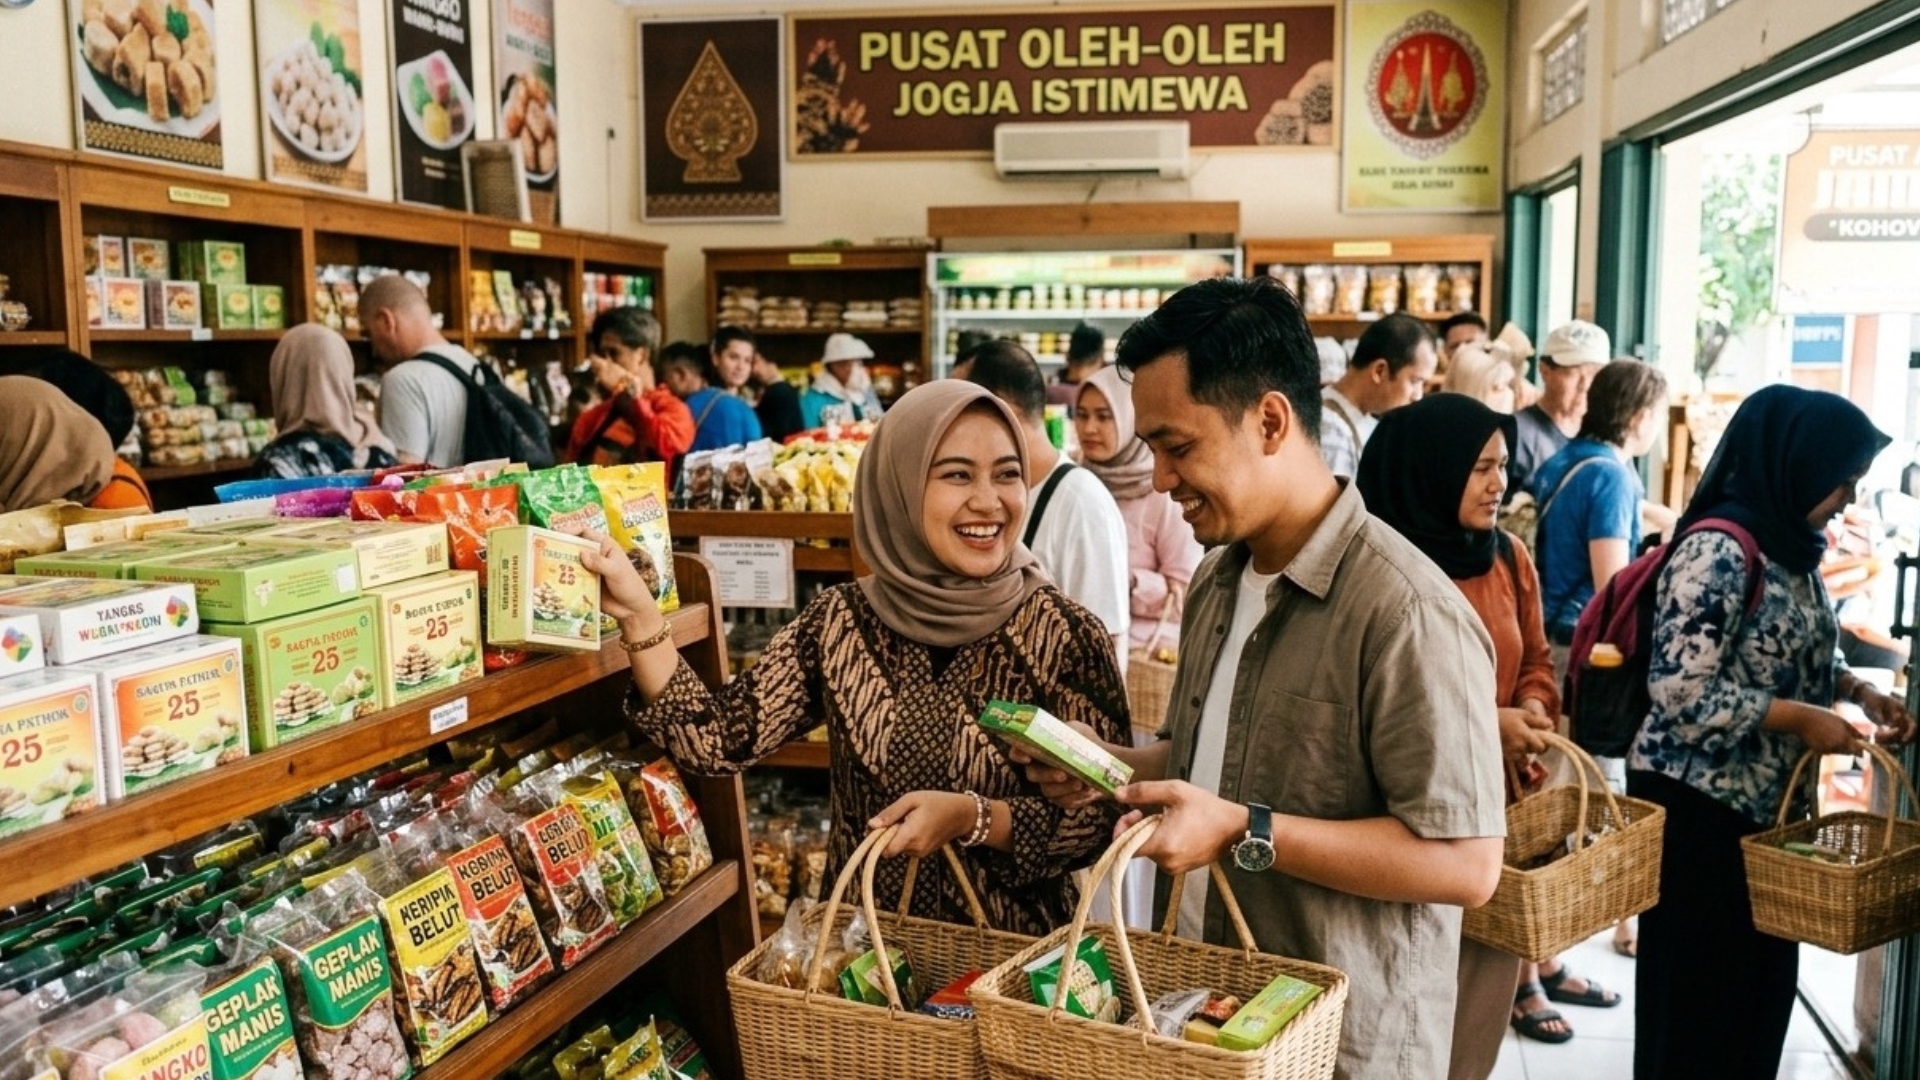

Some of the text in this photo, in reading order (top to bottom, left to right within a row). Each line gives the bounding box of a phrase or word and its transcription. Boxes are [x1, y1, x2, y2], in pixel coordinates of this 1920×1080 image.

[859, 22, 1286, 71] PUSAT OLEH-OLEH
[893, 75, 1249, 117] JOGJA ISTIMEWA
[1828, 145, 1909, 167] PUSAT
[426, 614, 449, 640] 25
[312, 646, 339, 675] 25
[167, 690, 200, 721] 25
[2, 733, 42, 769] 25
[409, 902, 462, 947] BELUT
[314, 929, 381, 980] GEPLAK
[328, 956, 384, 1003] MANIS
[204, 975, 282, 1033] GEPLAK
[218, 1003, 285, 1057] MANIS
